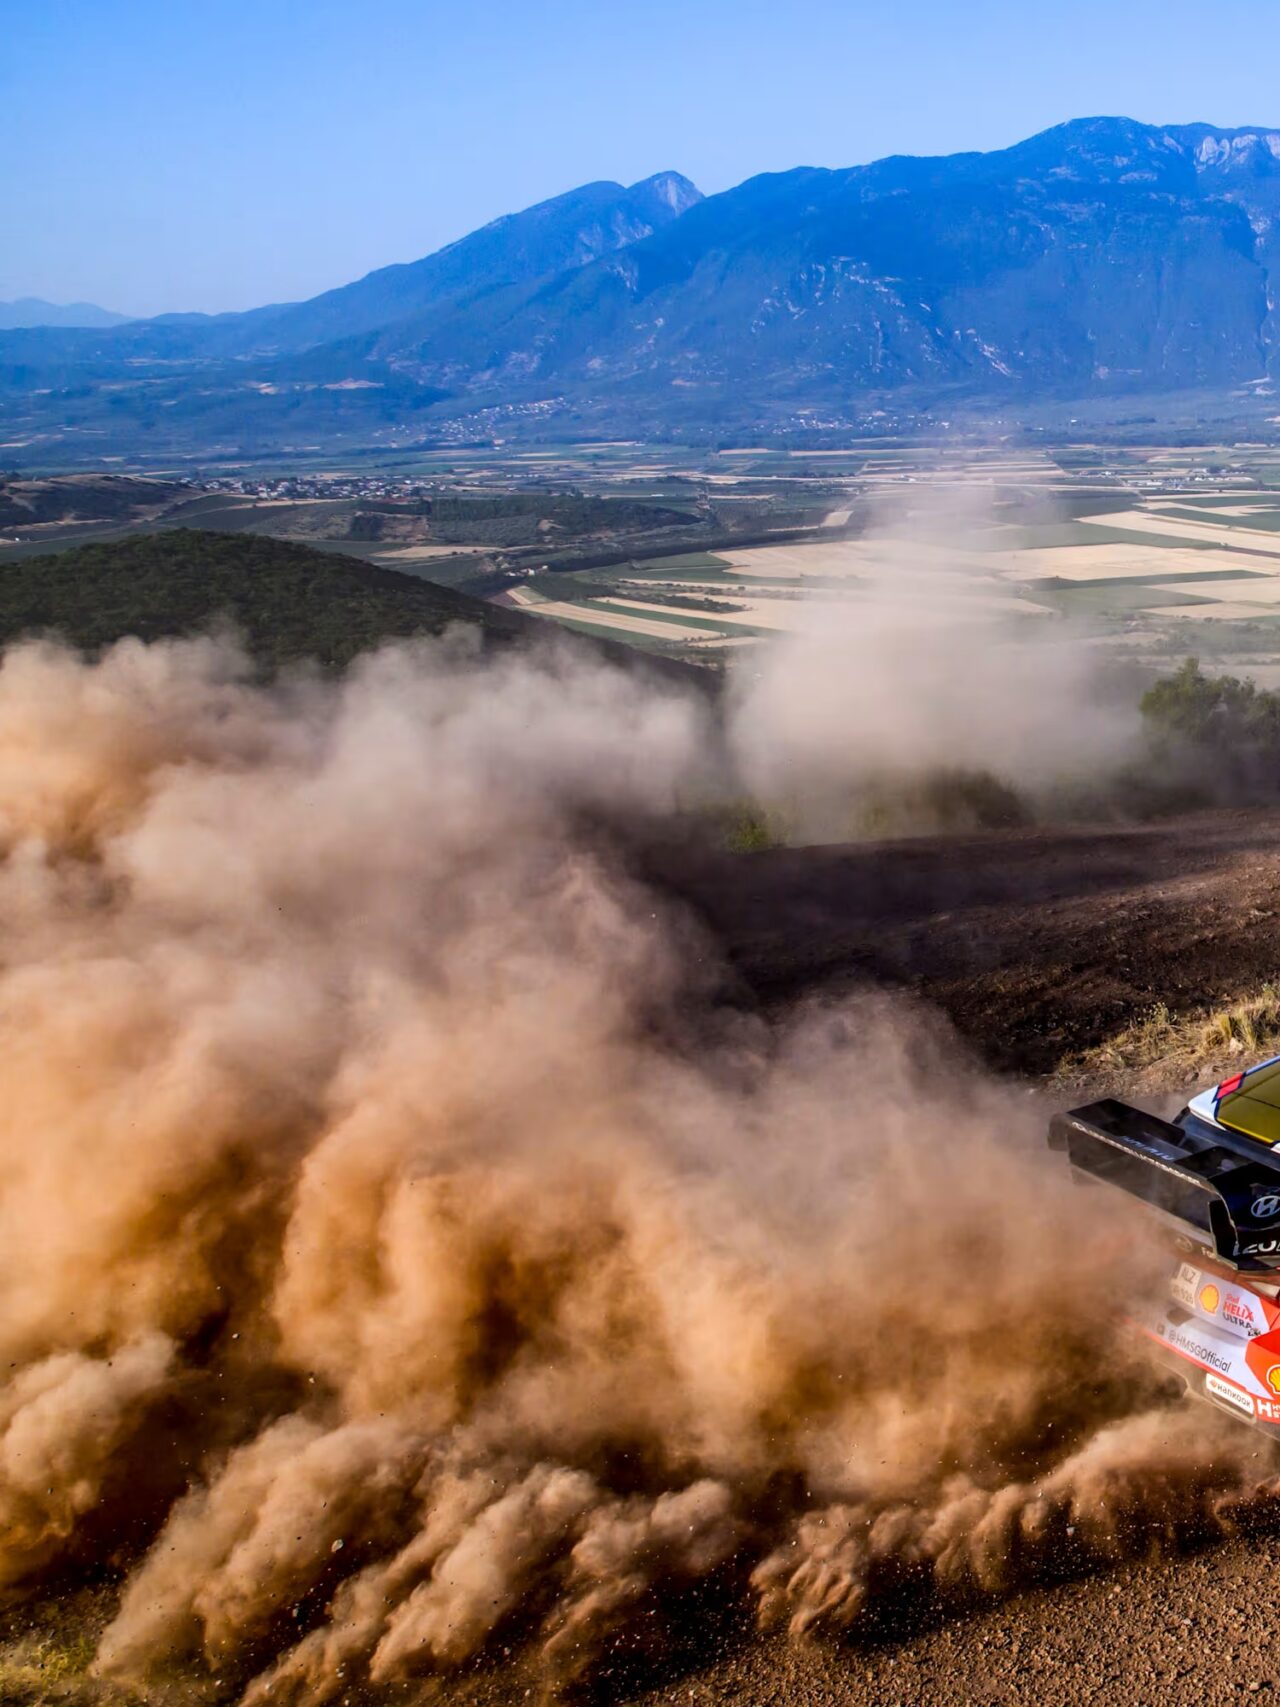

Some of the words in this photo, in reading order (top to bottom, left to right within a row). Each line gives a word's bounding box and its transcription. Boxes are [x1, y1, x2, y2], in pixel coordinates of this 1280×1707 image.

[1222, 1312, 1252, 1330] ULTRA
[1223, 1301, 1254, 1322] HELIX
[1168, 1329, 1232, 1373] @HMSGOfficial
